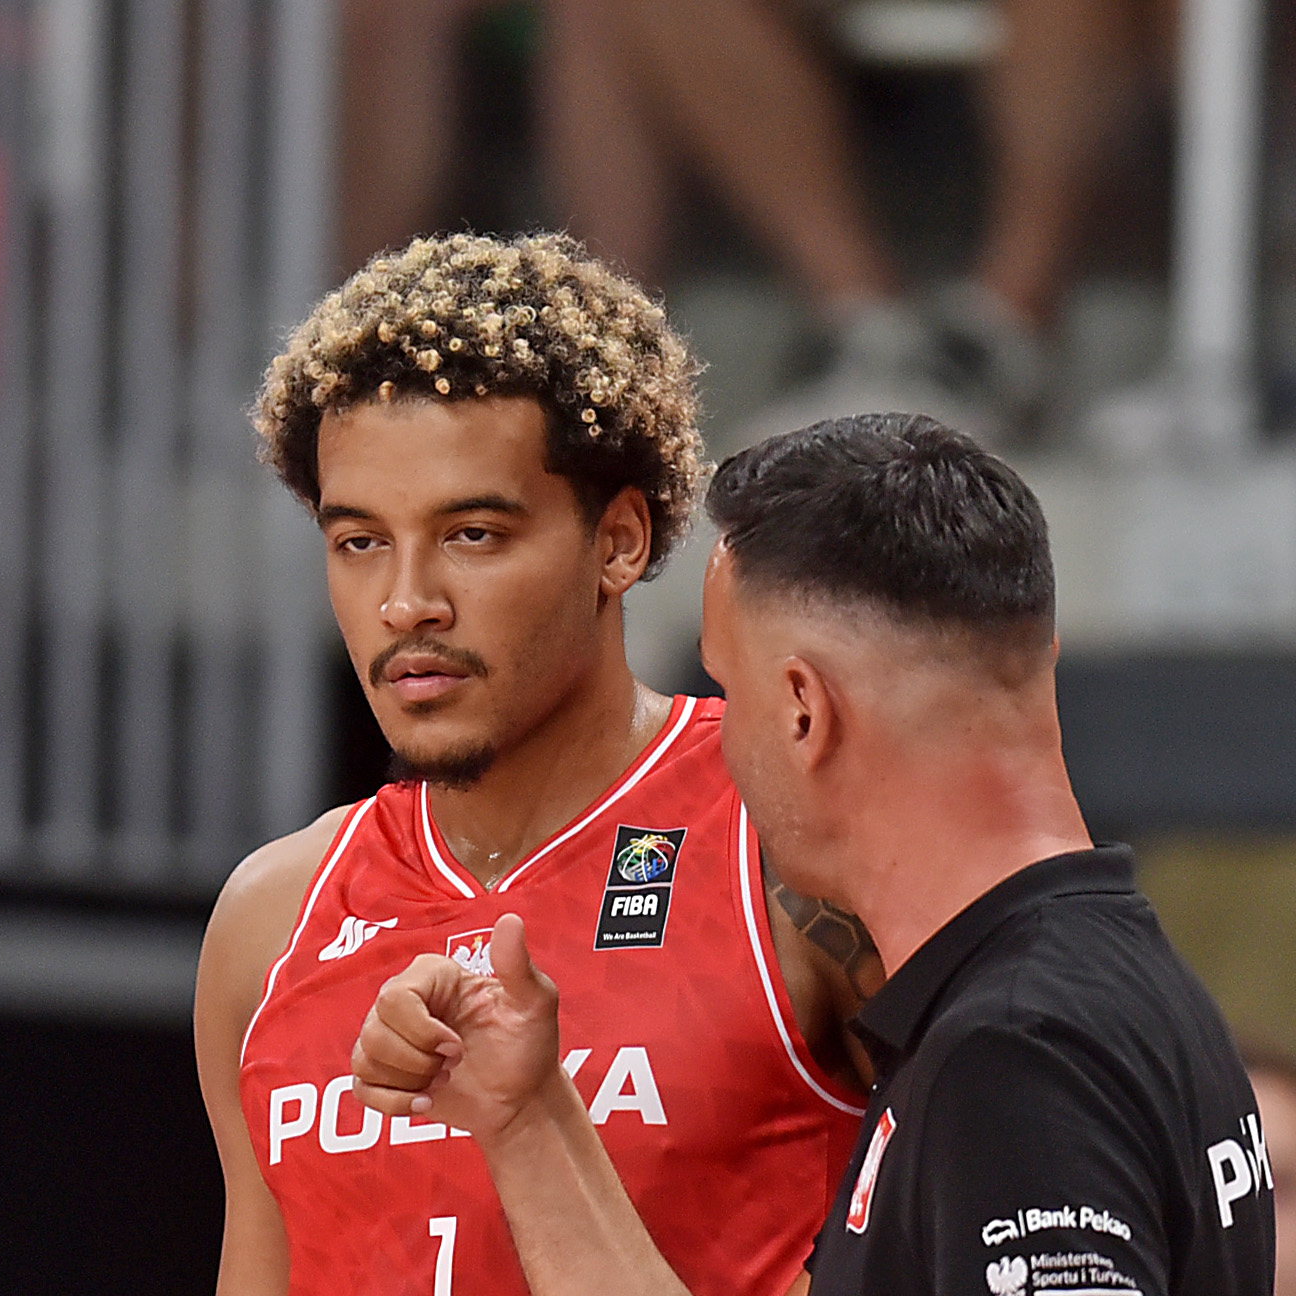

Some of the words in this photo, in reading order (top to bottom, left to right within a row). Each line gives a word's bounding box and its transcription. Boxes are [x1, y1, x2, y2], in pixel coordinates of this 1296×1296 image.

[610, 893, 659, 917] FIBA
[603, 932, 614, 941] We
[614, 932, 625, 940] Are
[625, 931, 657, 940] Basketball
[269, 1046, 668, 1166] POLA
[1025, 1205, 1077, 1233] Bank
[1079, 1205, 1132, 1242] Pekao
[1031, 1269, 1079, 1288] Sportu
